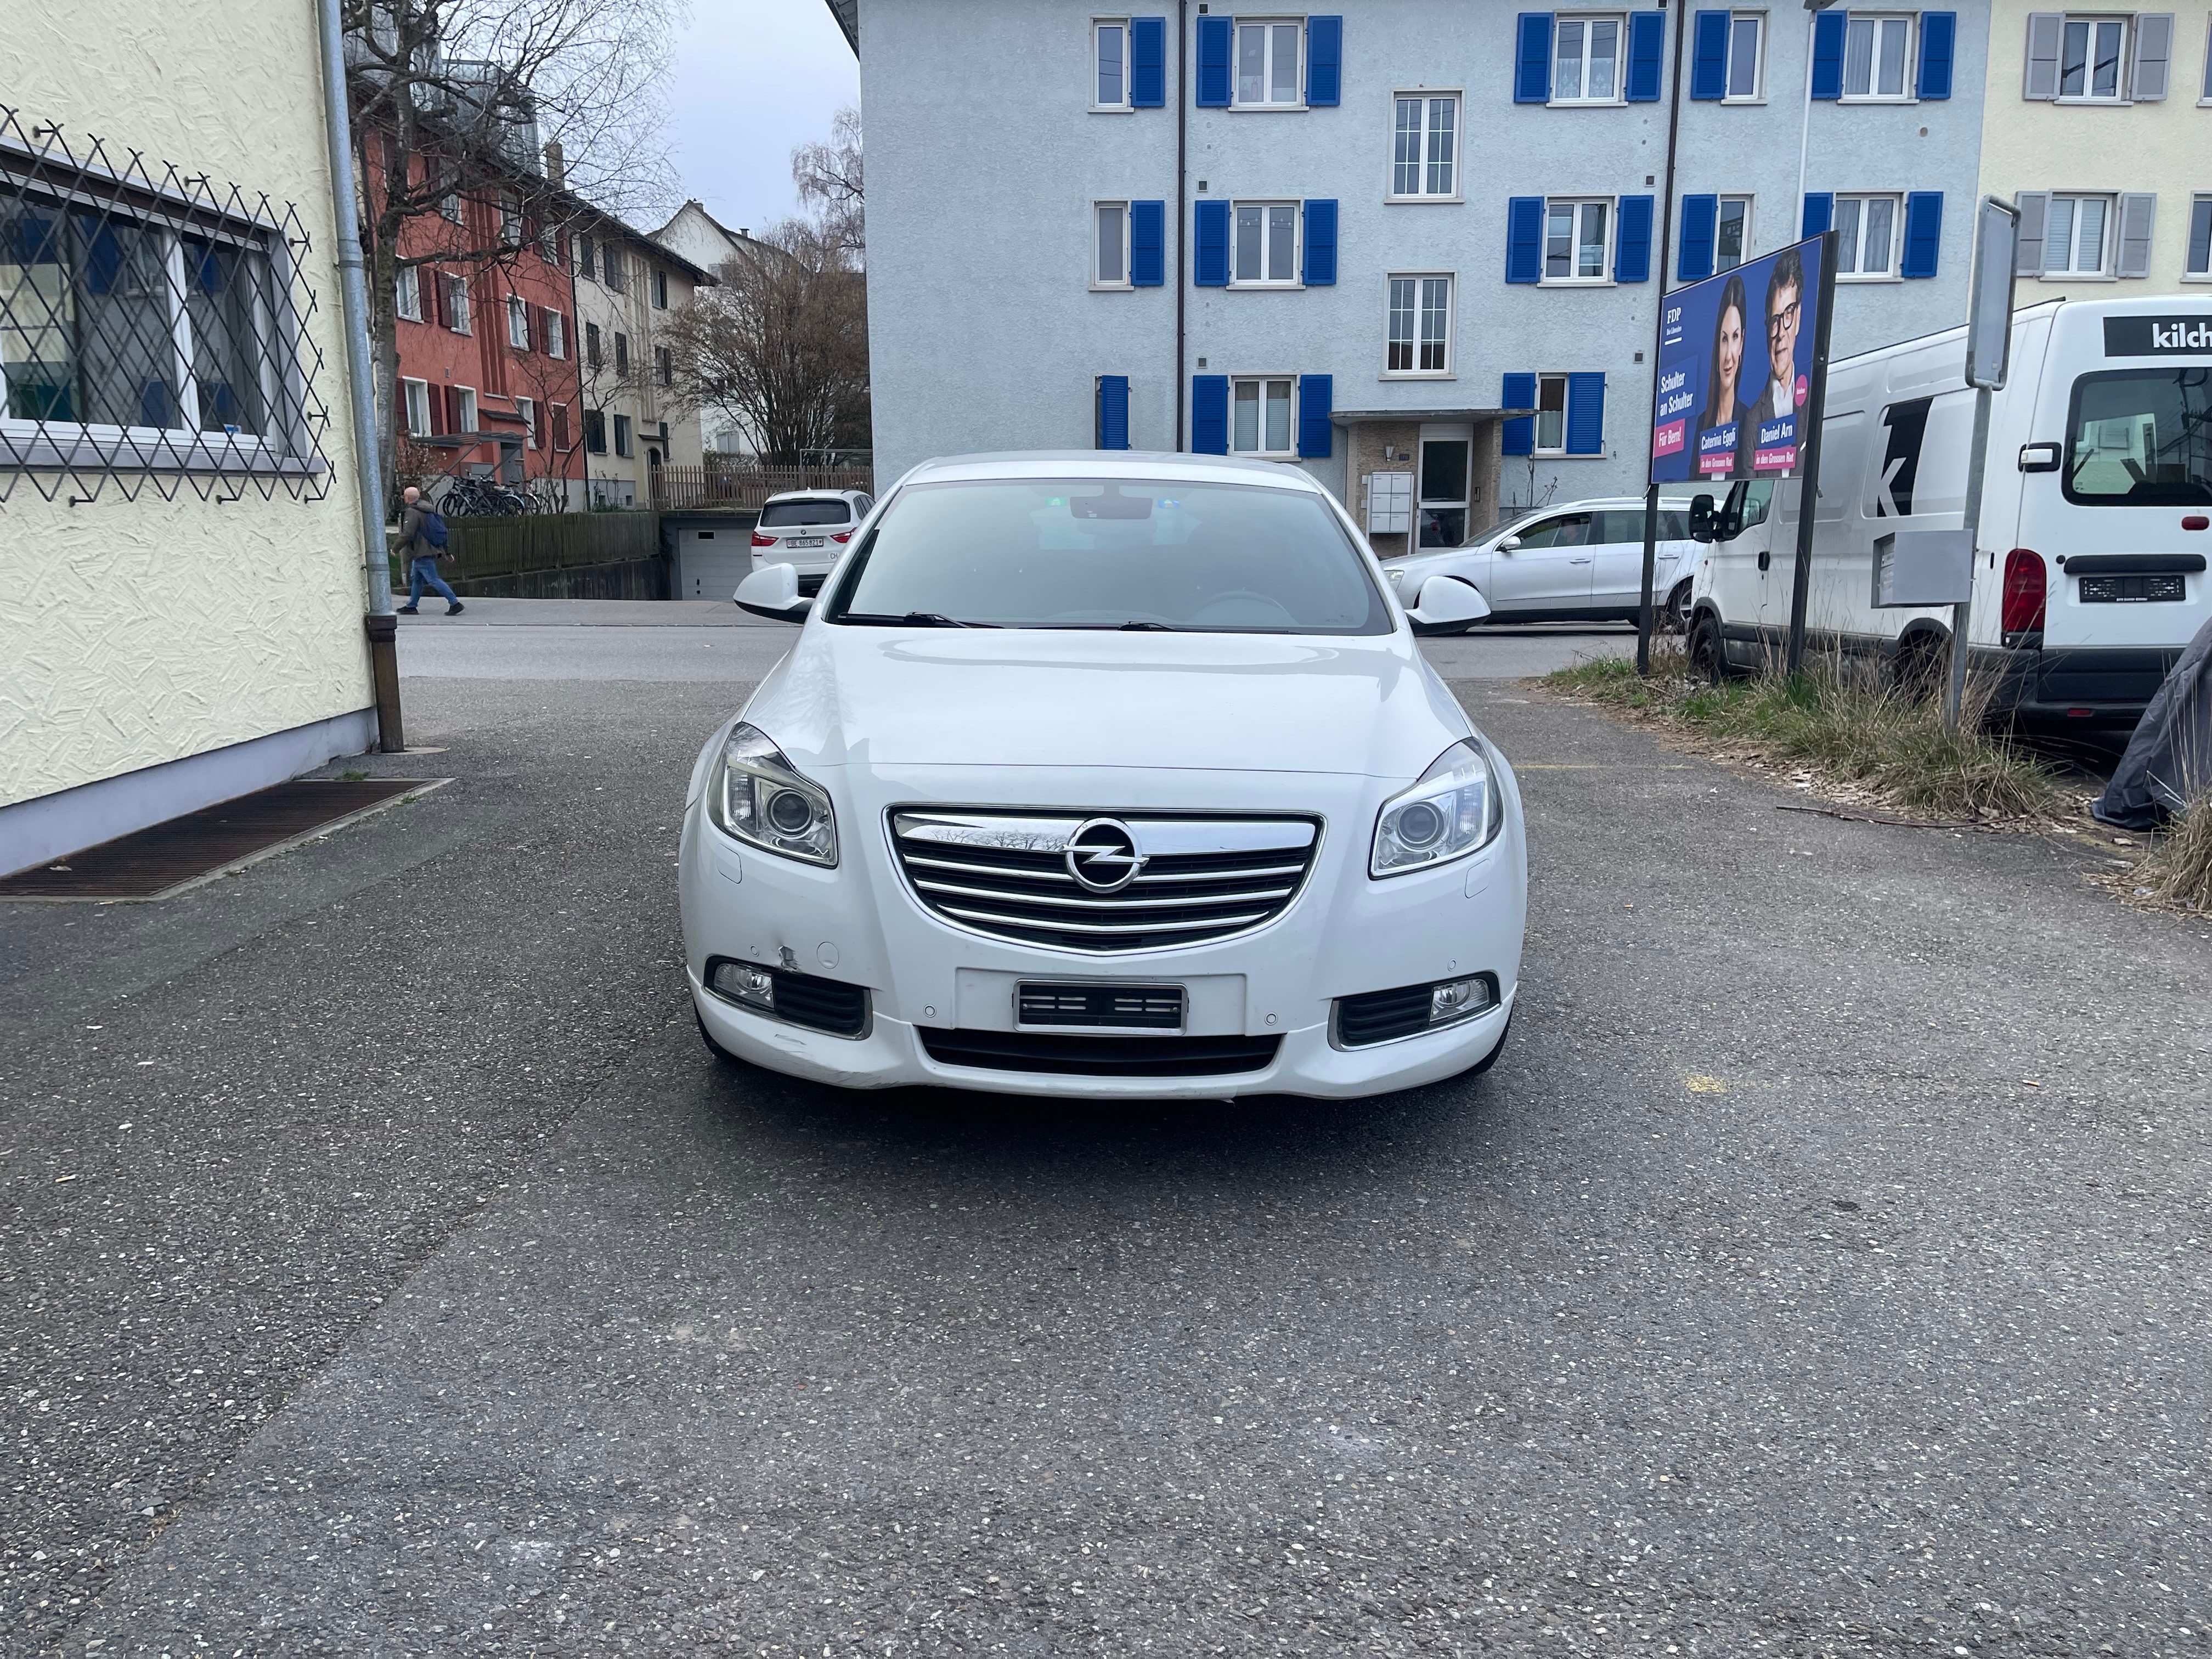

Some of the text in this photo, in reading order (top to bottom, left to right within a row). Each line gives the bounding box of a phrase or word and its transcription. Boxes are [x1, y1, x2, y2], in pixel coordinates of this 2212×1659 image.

[1667, 307, 1681, 324] FDP
[2152, 323, 2212, 348] kilch
[1661, 371, 1685, 393] Schulter
[1660, 391, 1694, 417] an Schulter
[1659, 426, 1681, 448] Für Bern!
[1701, 427, 1736, 450] Caterina Eggli
[1761, 422, 1793, 444] Daniel Arn
